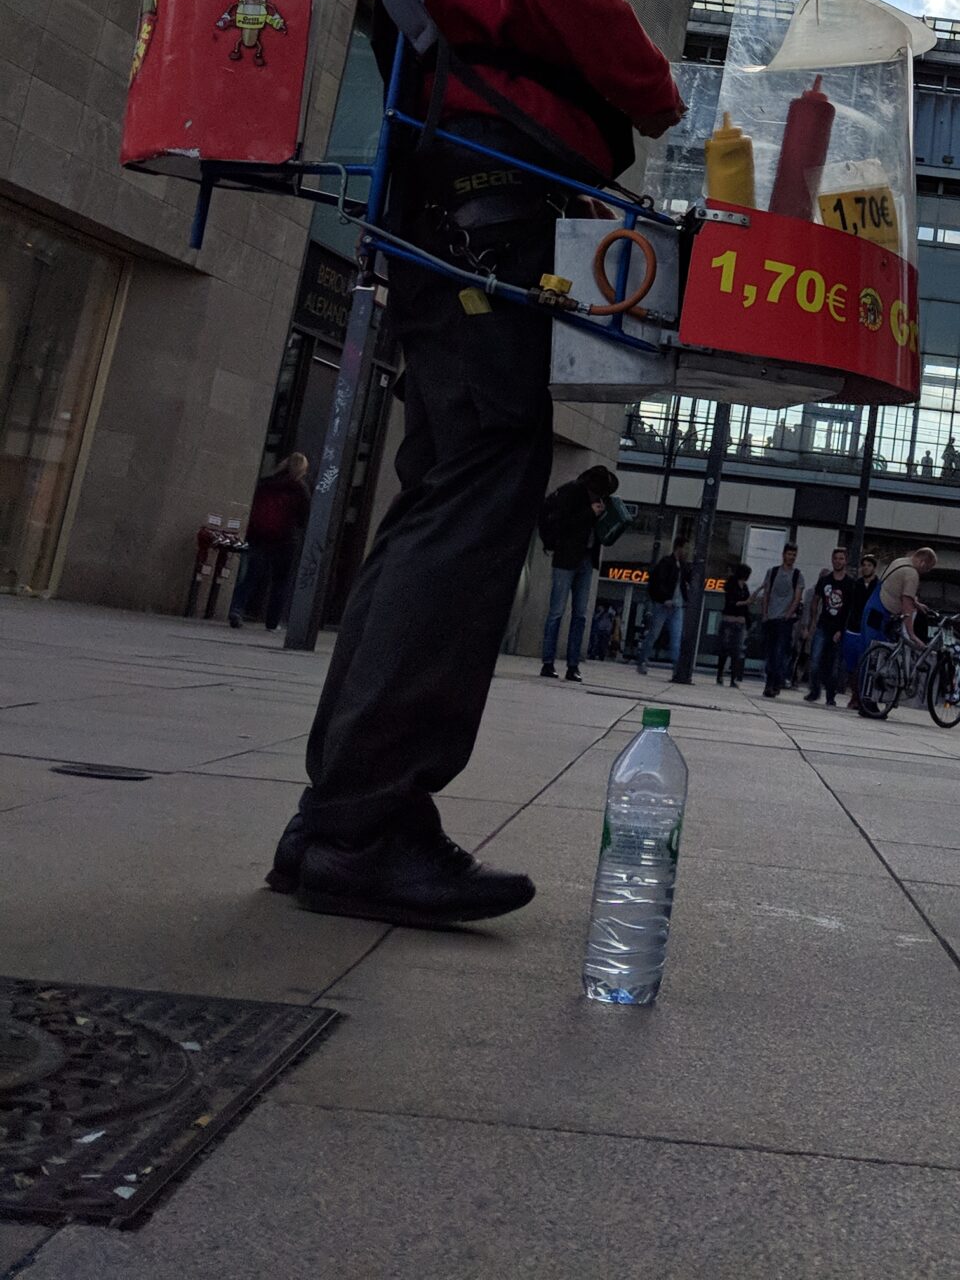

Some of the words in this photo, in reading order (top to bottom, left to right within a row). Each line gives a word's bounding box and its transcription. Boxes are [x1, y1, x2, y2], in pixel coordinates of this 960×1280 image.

[833, 195, 893, 235] 1,70€
[304, 292, 349, 327] ALEXAND
[711, 249, 848, 323] 1,70€
[890, 299, 919, 352] Gr
[608, 567, 650, 583] WECH
[704, 578, 727, 591] BE
